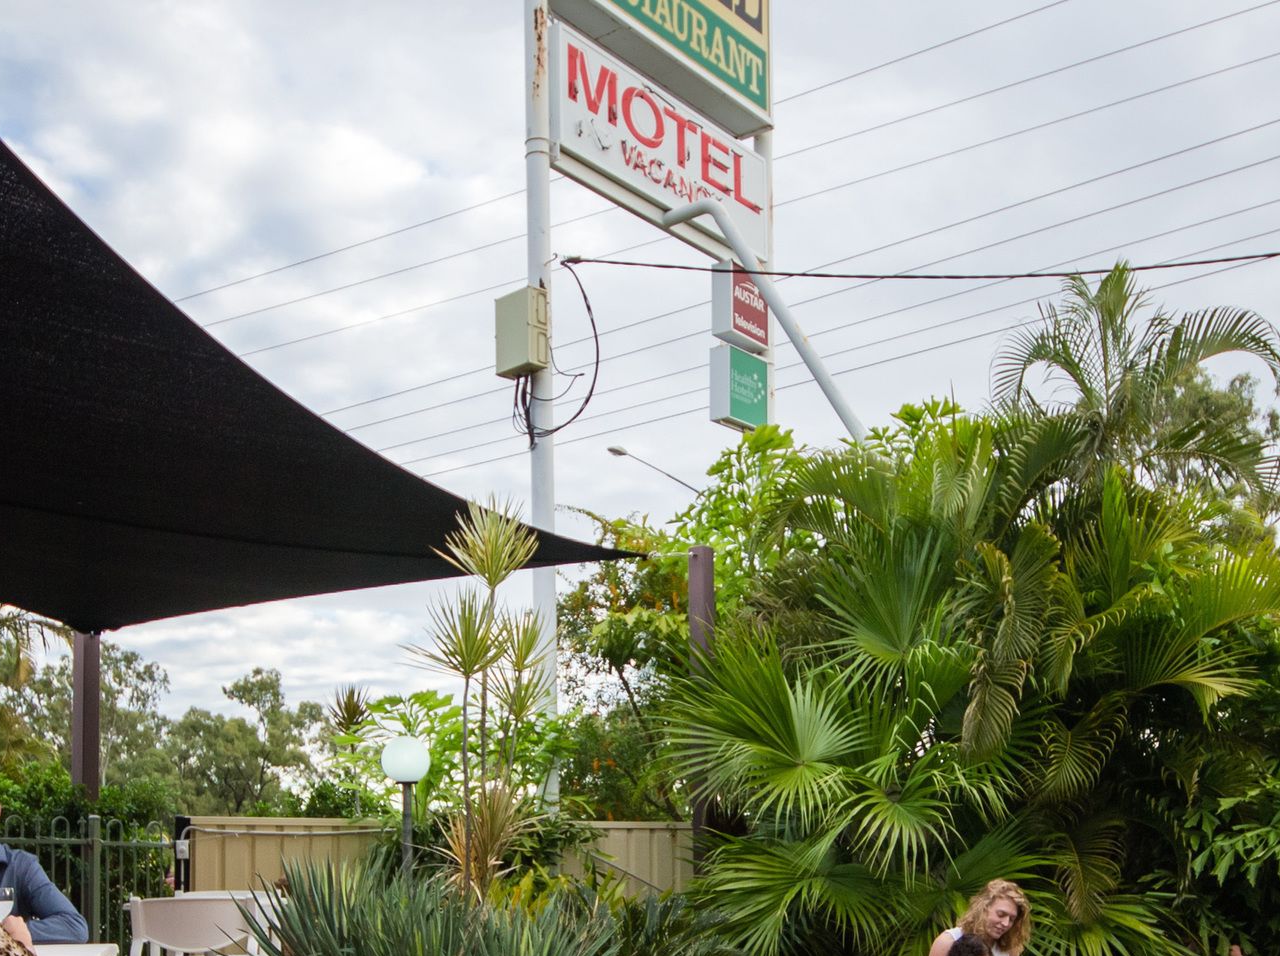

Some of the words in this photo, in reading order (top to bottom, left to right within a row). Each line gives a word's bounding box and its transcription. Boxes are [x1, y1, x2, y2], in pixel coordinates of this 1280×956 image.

[567, 42, 763, 216] MOTEL
[734, 284, 766, 313] AUSTAR
[734, 311, 766, 340] Television
